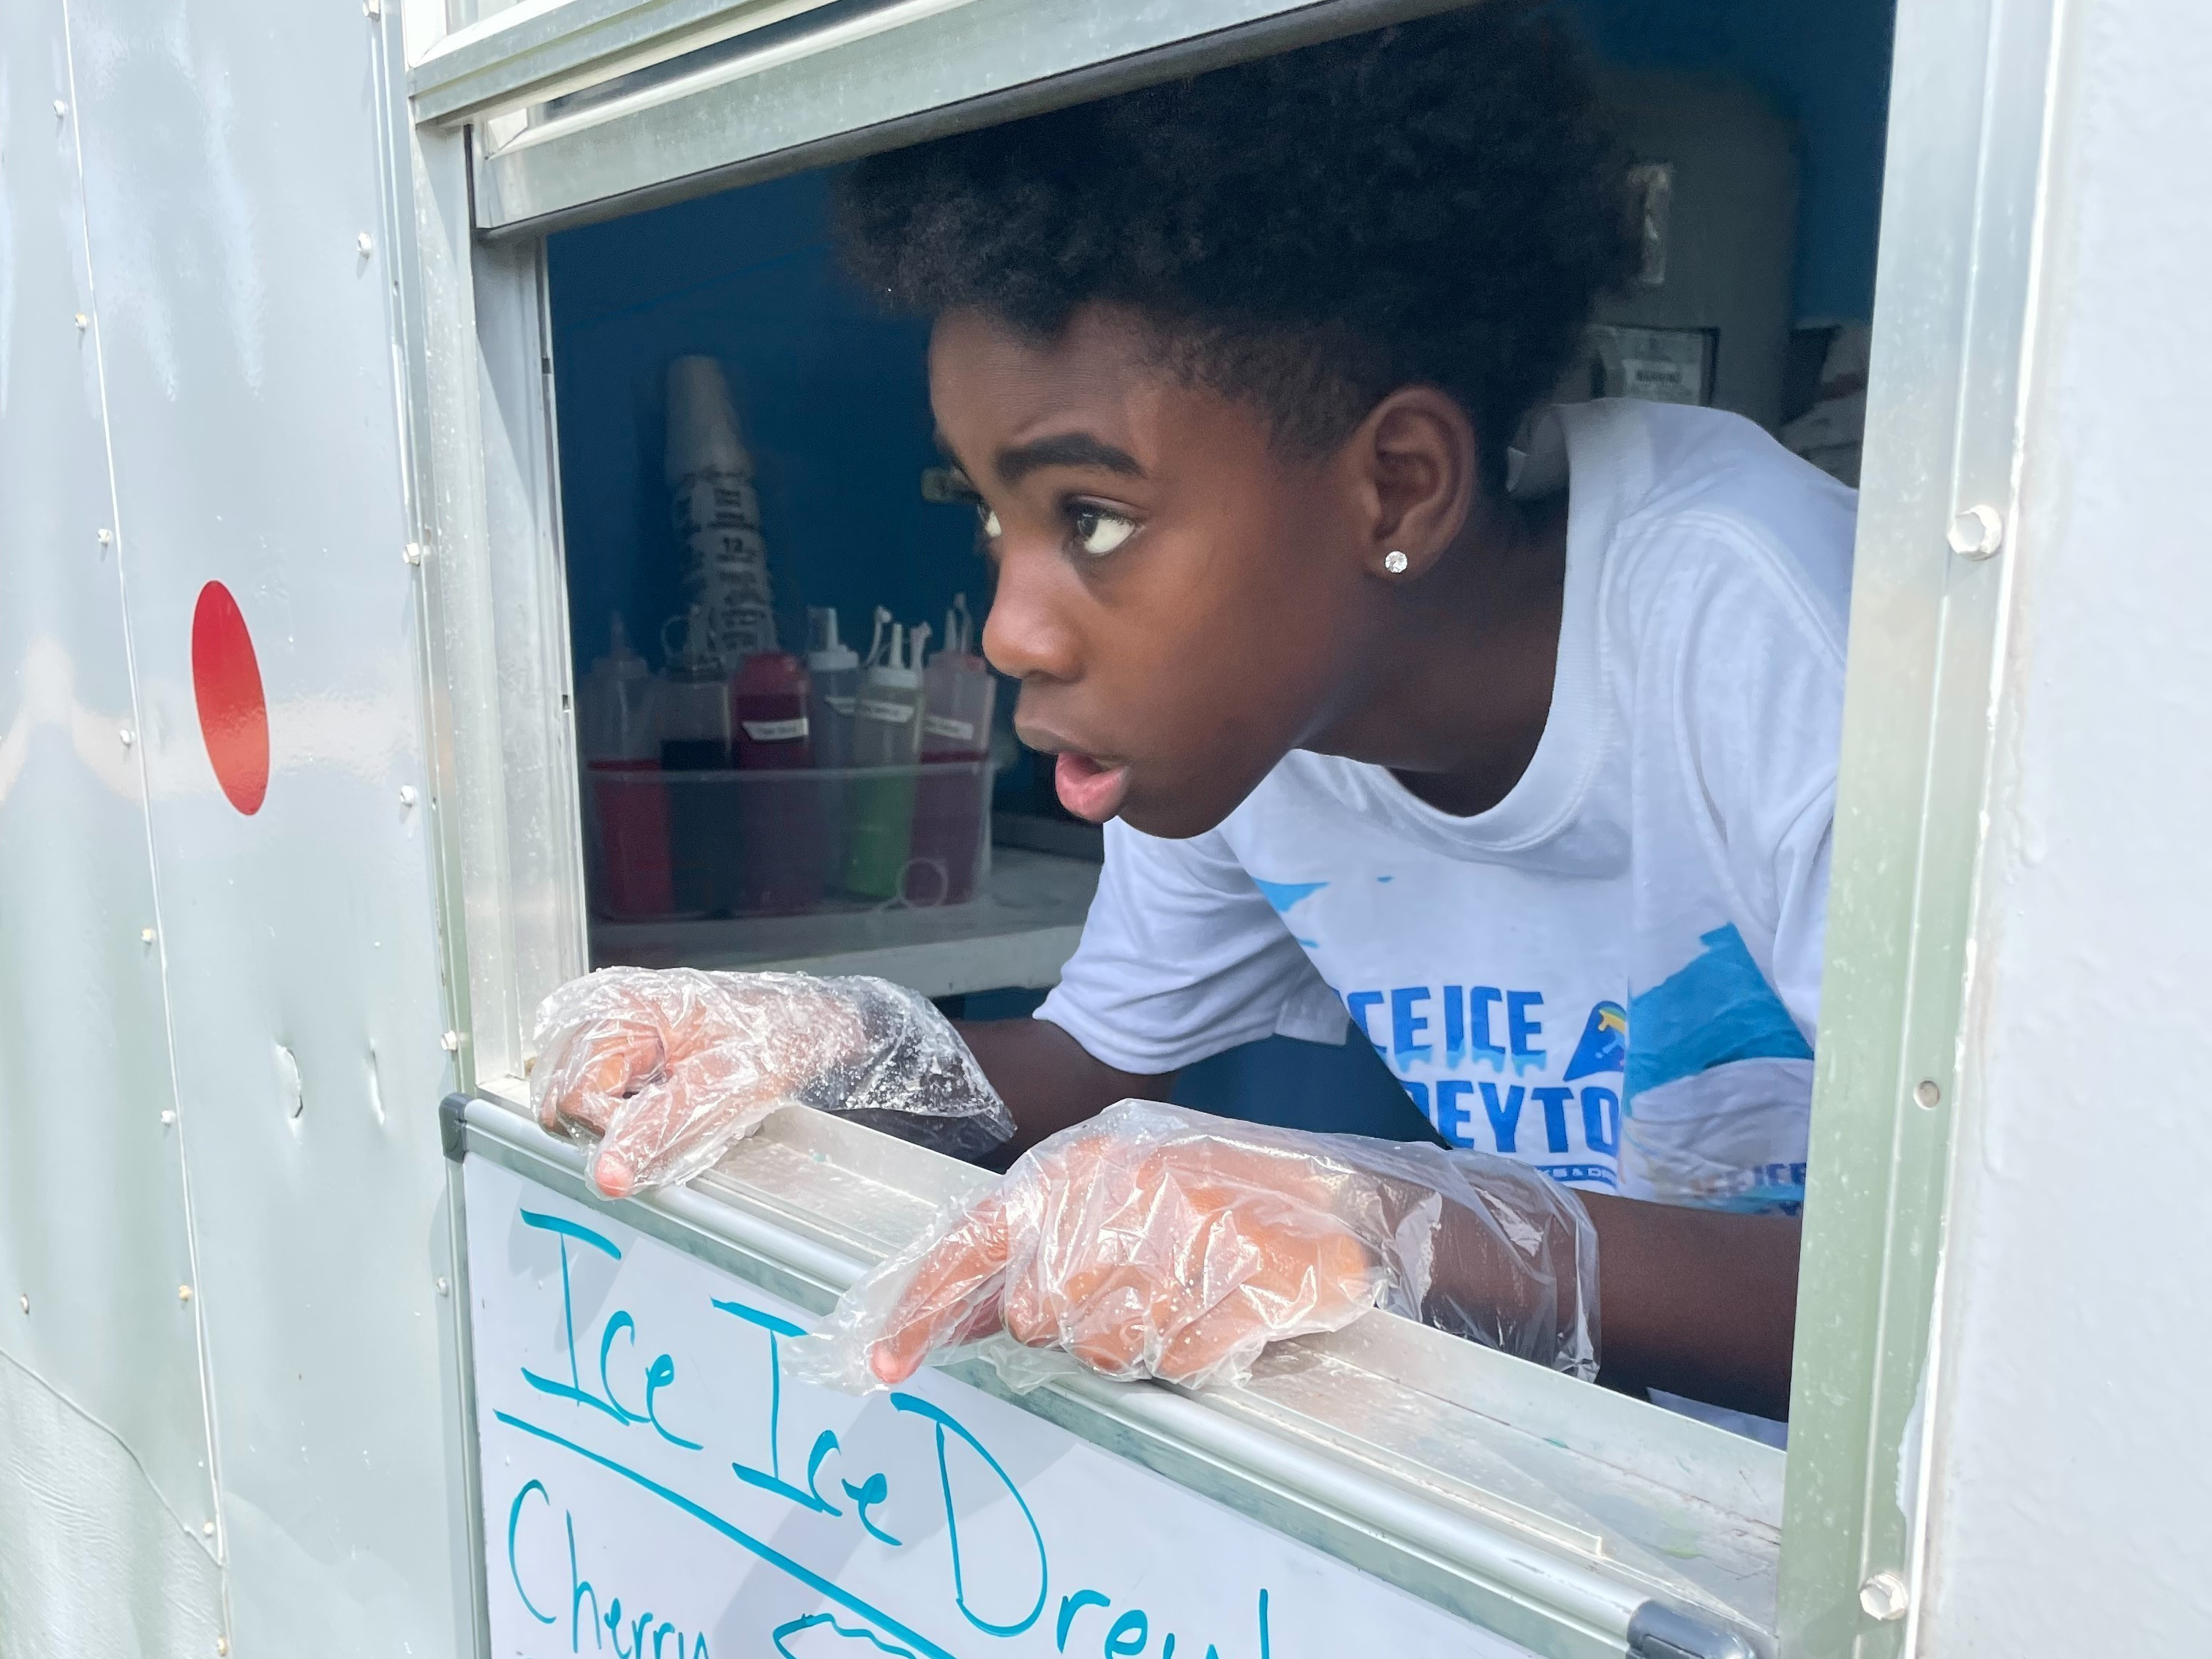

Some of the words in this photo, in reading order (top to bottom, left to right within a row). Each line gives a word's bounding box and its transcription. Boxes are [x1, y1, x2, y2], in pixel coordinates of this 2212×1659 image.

[1332, 986, 1432, 1072] CE
[1443, 985, 1546, 1077] ICE
[519, 1207, 703, 1450] Ice
[709, 1293, 903, 1546] Ice
